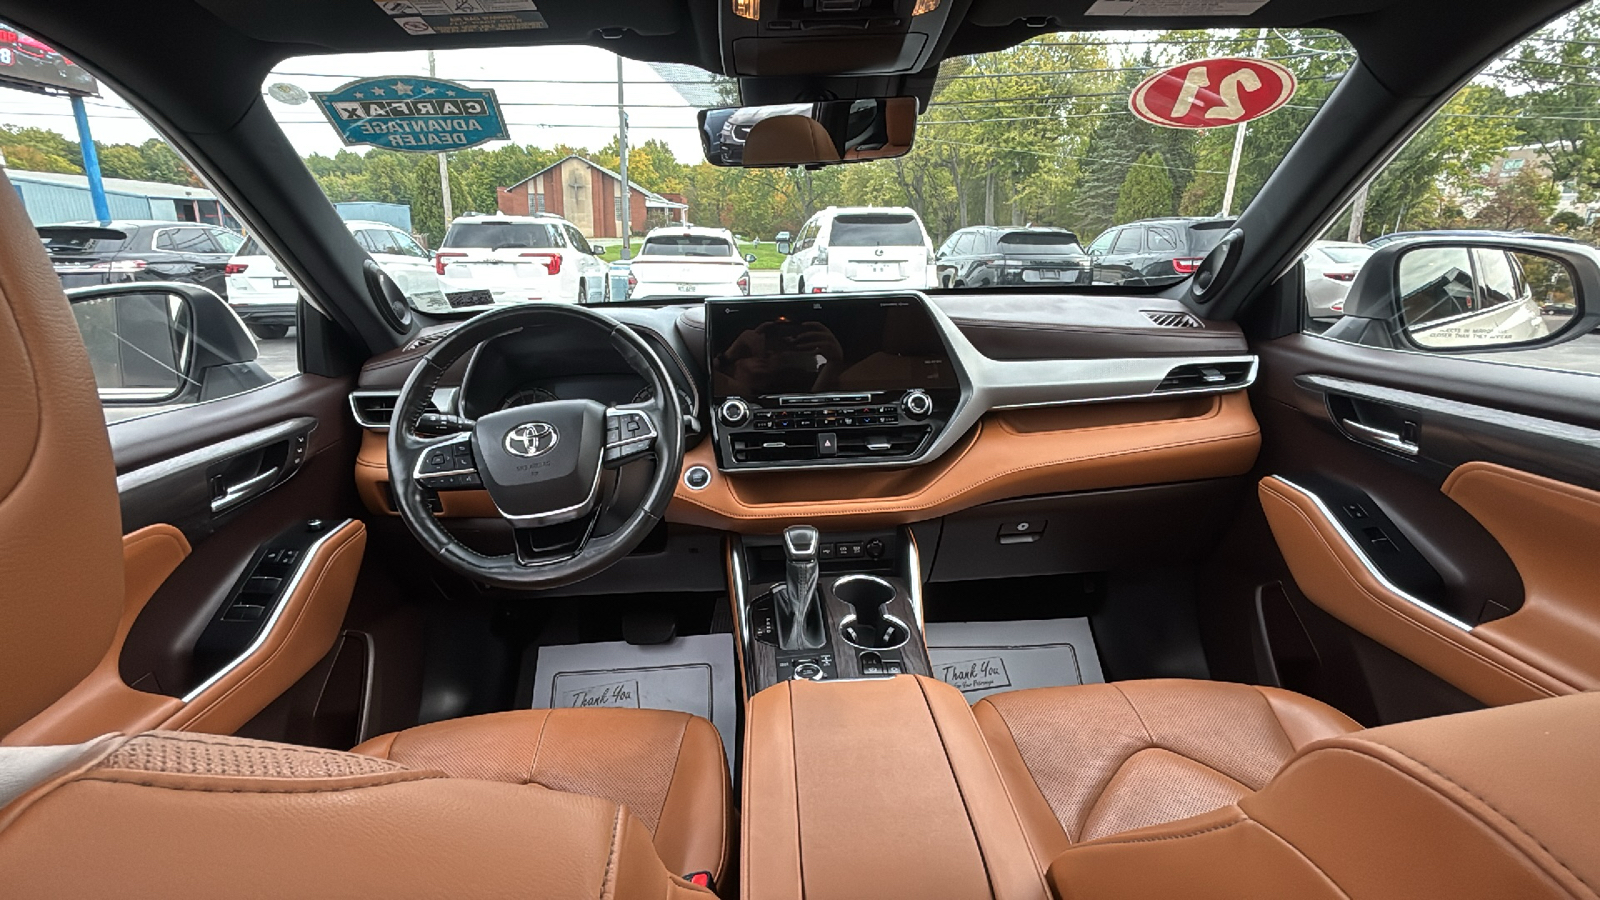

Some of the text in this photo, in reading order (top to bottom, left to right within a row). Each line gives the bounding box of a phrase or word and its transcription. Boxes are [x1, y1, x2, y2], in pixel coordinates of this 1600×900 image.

[942, 660, 1000, 684] Thank You
[572, 684, 632, 708] Thank You
